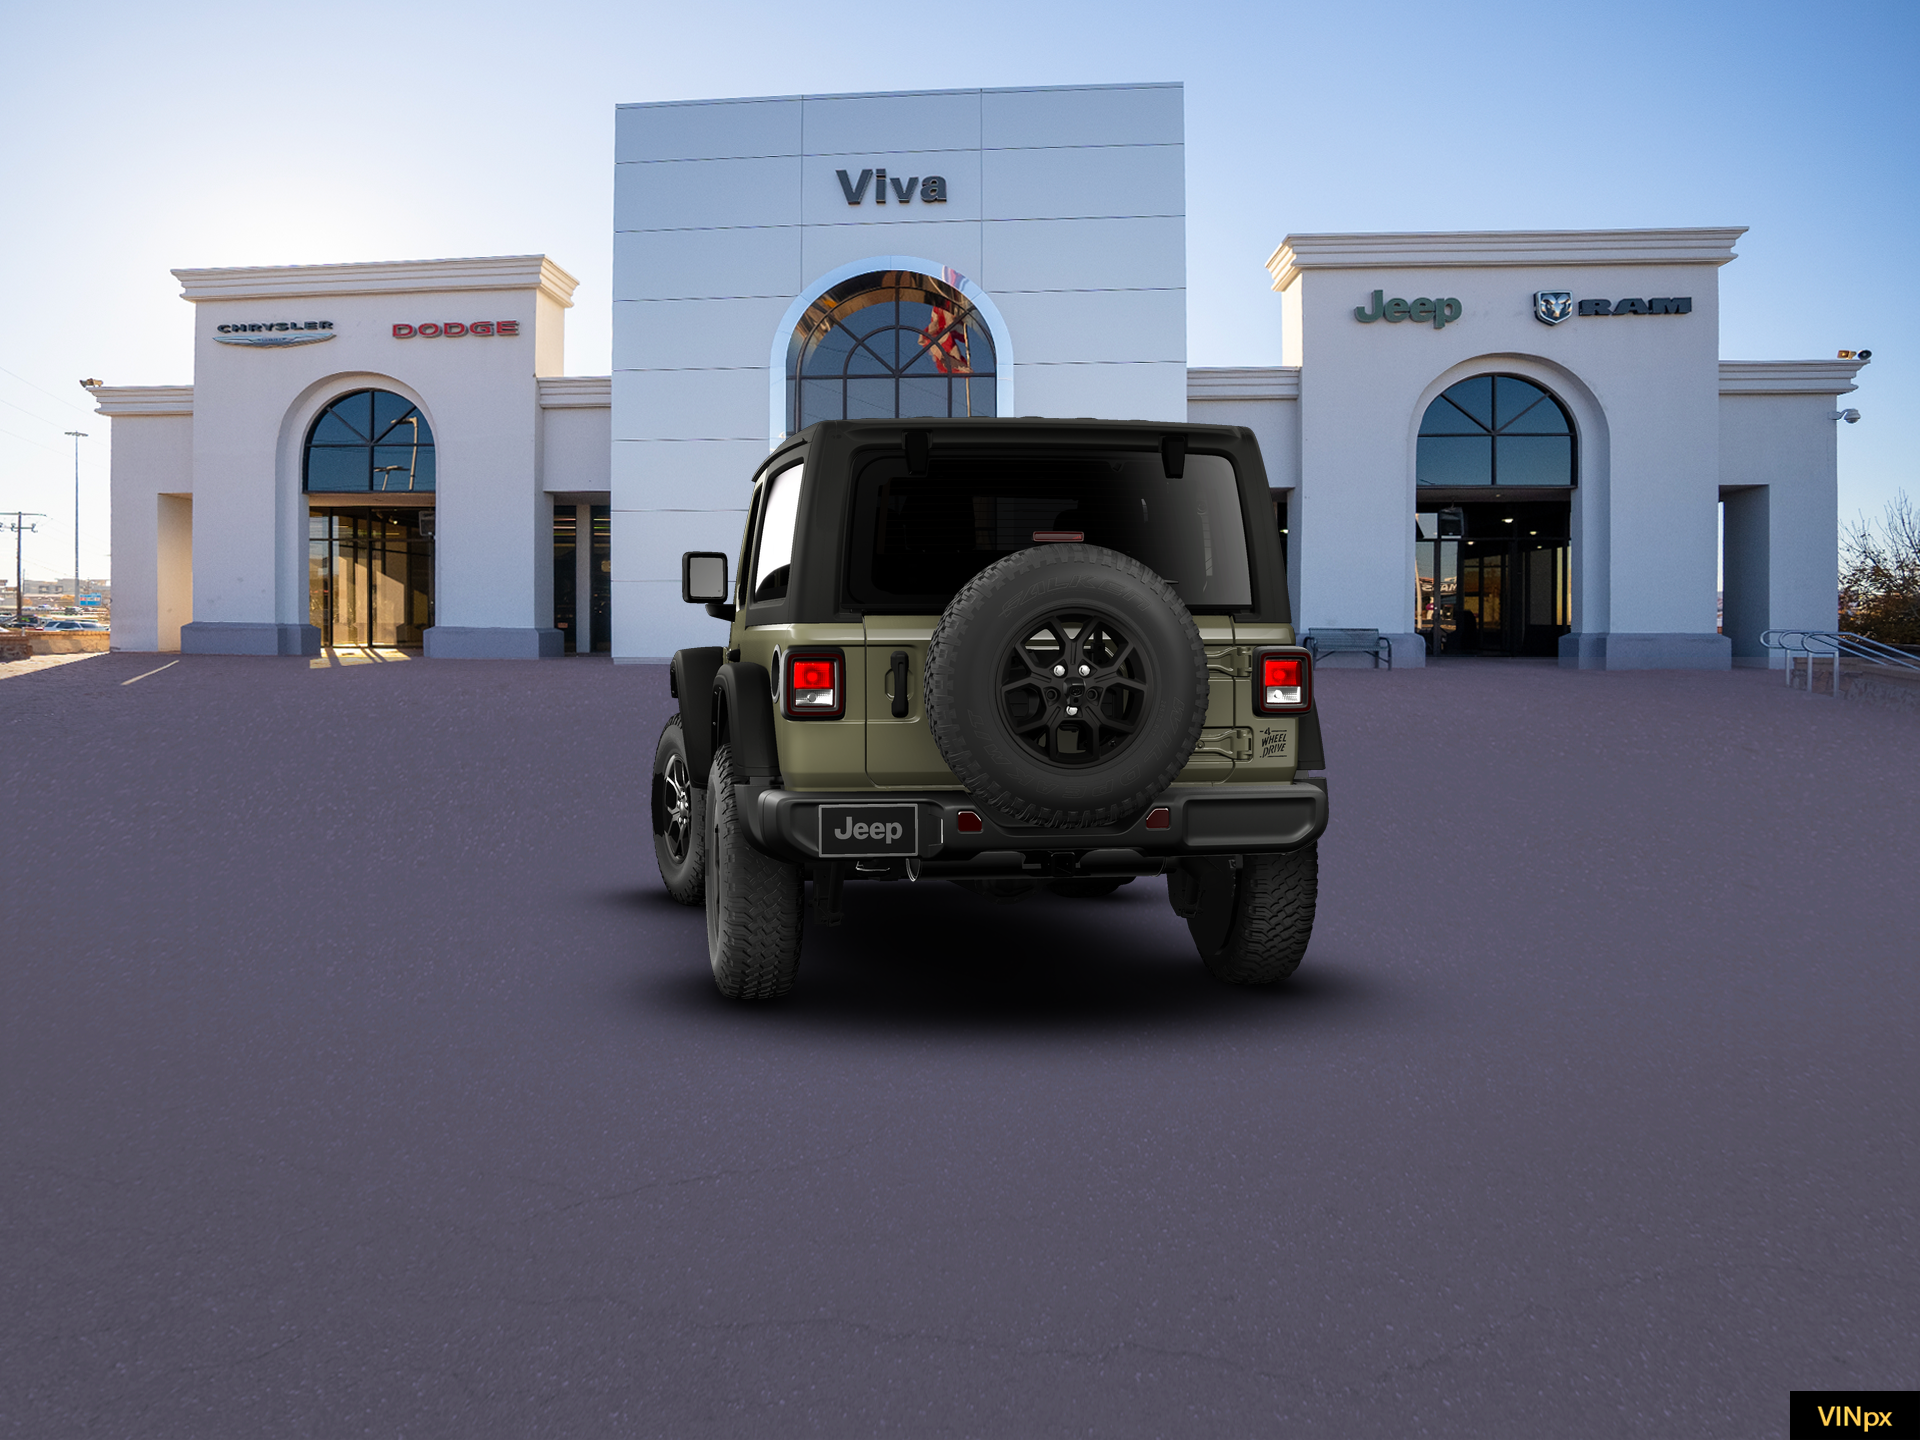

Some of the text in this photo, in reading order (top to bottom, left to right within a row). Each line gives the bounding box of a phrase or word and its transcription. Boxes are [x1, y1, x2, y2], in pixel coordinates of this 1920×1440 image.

[835, 168, 948, 205] Viva
[1354, 289, 1463, 329] Jeep
[1578, 296, 1693, 316] RAM
[217, 320, 334, 334] CHRYSLER
[391, 320, 520, 339] DODGE
[998, 575, 1153, 618] FALKEN
[1261, 733, 1287, 747] WHEEL
[1264, 727, 1271, 735] 4
[1262, 743, 1287, 758] DRIVE
[834, 816, 903, 844] Jeep
